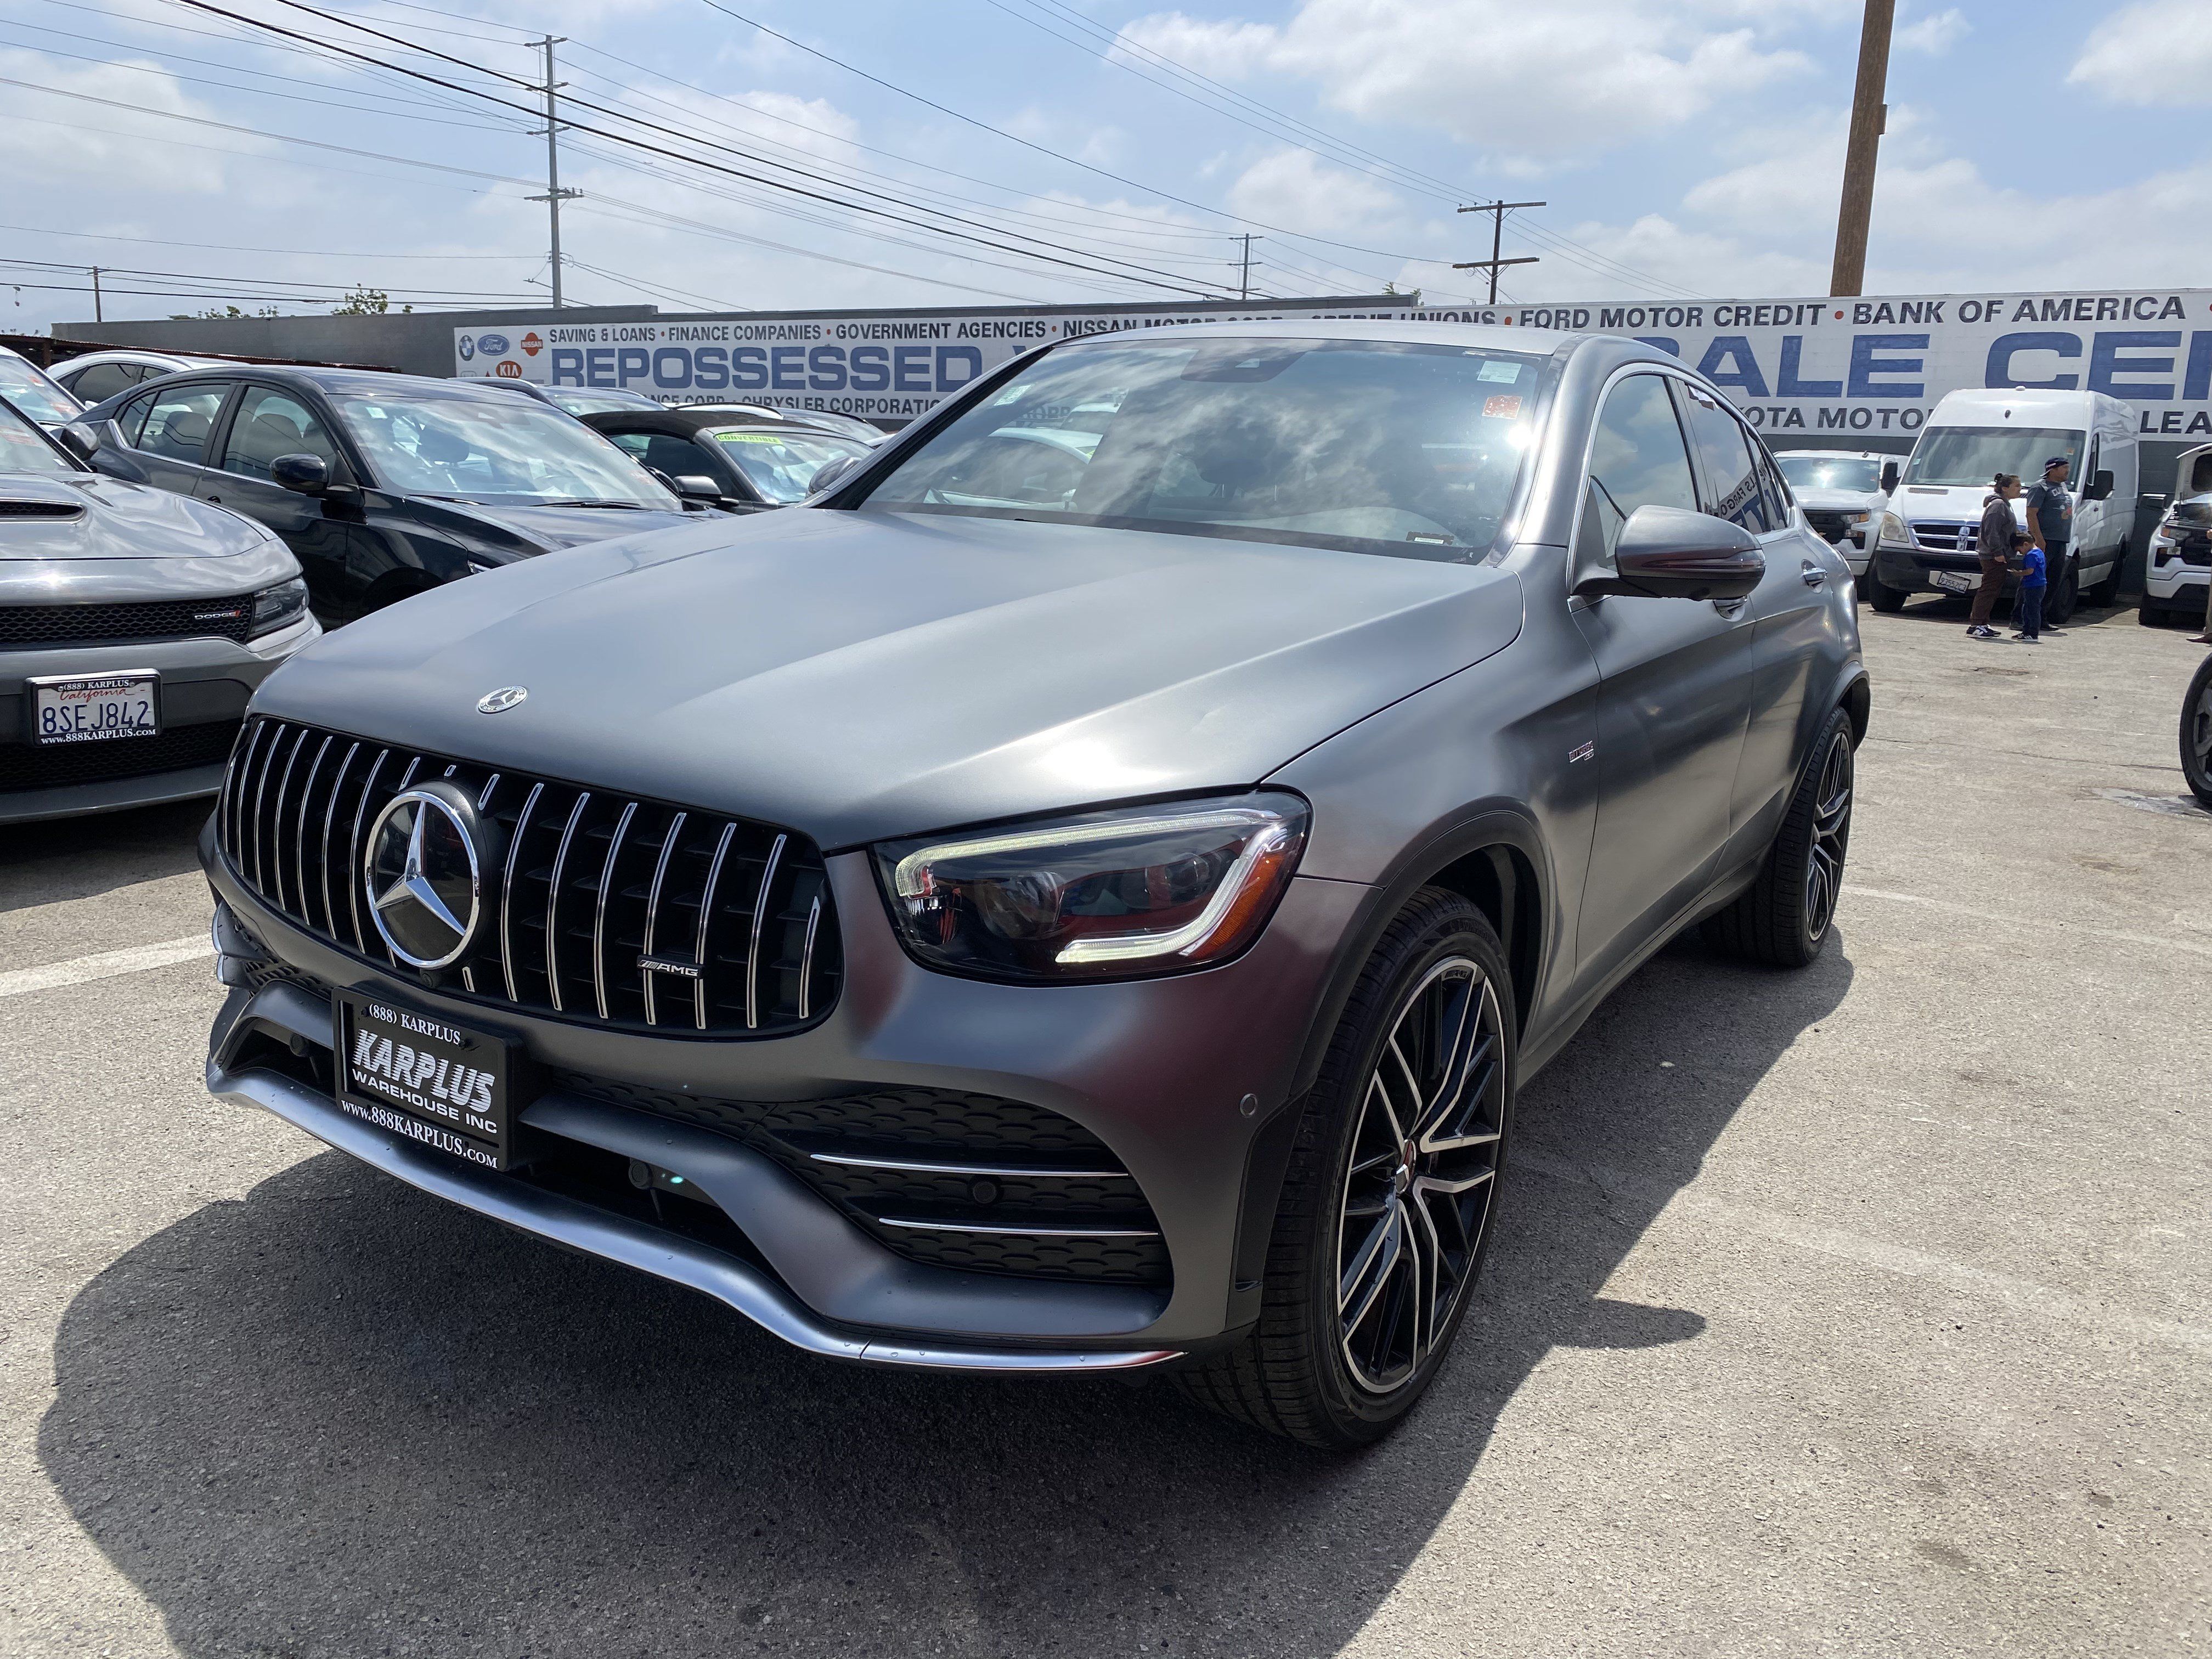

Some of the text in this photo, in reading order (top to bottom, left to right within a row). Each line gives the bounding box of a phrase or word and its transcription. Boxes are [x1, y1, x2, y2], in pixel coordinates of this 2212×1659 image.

[549, 328, 596, 343] SAVING
[601, 329, 608, 342] &
[613, 327, 656, 342] LOANS
[669, 325, 729, 341] FINANCE
[734, 324, 821, 340] COMPANIES
[836, 323, 952, 340] GOVERNMENT
[957, 321, 1046, 338] AGENCIES
[1520, 309, 1590, 330] FORD
[1600, 307, 1703, 328] MOTOR
[1714, 304, 1827, 327] CREDIT
[1852, 301, 1946, 325] BANK
[1958, 300, 2005, 323] OF
[2011, 296, 2187, 322] AMERICA
[484, 338, 503, 351] Ford
[499, 364, 518, 376] KIA
[551, 331, 2212, 400] REPOSSESSED ALE CE
[1739, 407, 1806, 428] OTA
[194, 612, 236, 620] DODGE
[59, 688, 135, 703] California
[64, 680, 129, 691] (888) KARPLUS
[42, 701, 150, 733] 8SEJ842
[657, 962, 699, 977] AMG
[369, 1003, 461, 1045] (888) KARPLUS
[352, 1029, 495, 1113] KARPLUS
[352, 1069, 498, 1134] WAREHOUSE INC
